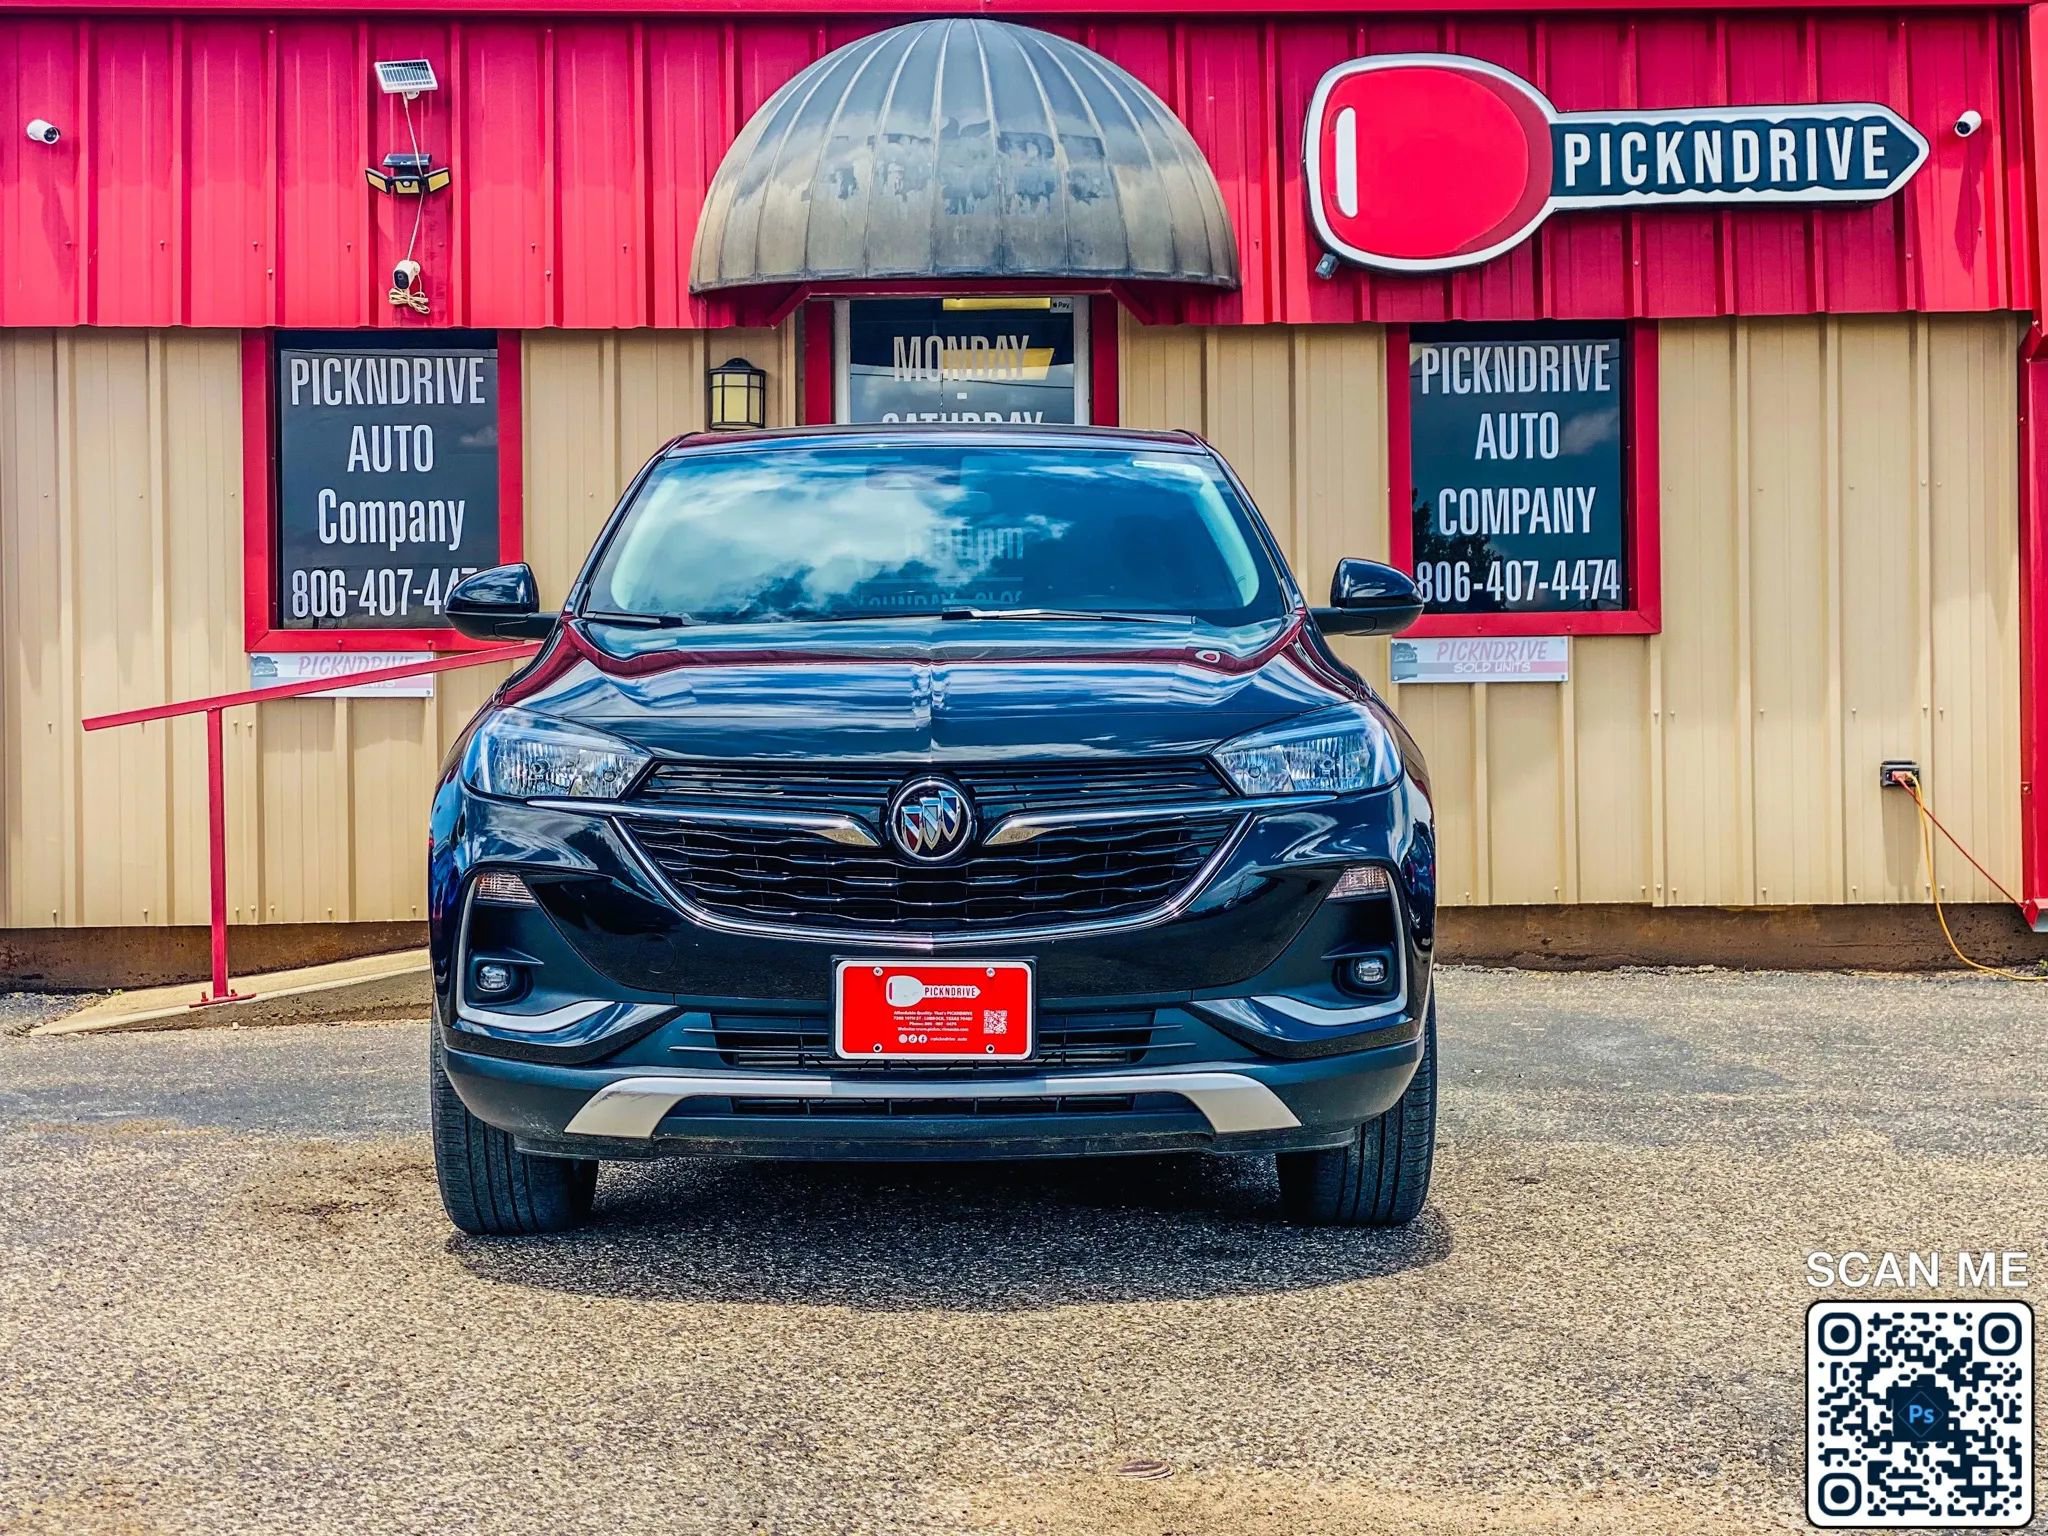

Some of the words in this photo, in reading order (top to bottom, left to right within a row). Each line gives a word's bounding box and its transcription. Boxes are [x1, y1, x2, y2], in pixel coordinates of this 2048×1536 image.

[1564, 125, 1889, 187] PICKNDRIVE
[290, 357, 486, 405] PICKNDRIVE
[893, 334, 1029, 382] MONDAY
[1421, 344, 1611, 395] PICKNDRIVE
[347, 424, 434, 473] AUTO
[1474, 411, 1560, 460] AUTO
[318, 488, 466, 552] Company
[1438, 486, 1597, 536] COMPANY
[1417, 559, 1621, 603] 806-407-4474
[1436, 640, 1548, 662] PICKNDRIVE
[1454, 662, 1490, 673] SOLD
[1495, 662, 1531, 673] UNITS
[924, 986, 977, 997] PICKNDRIVE
